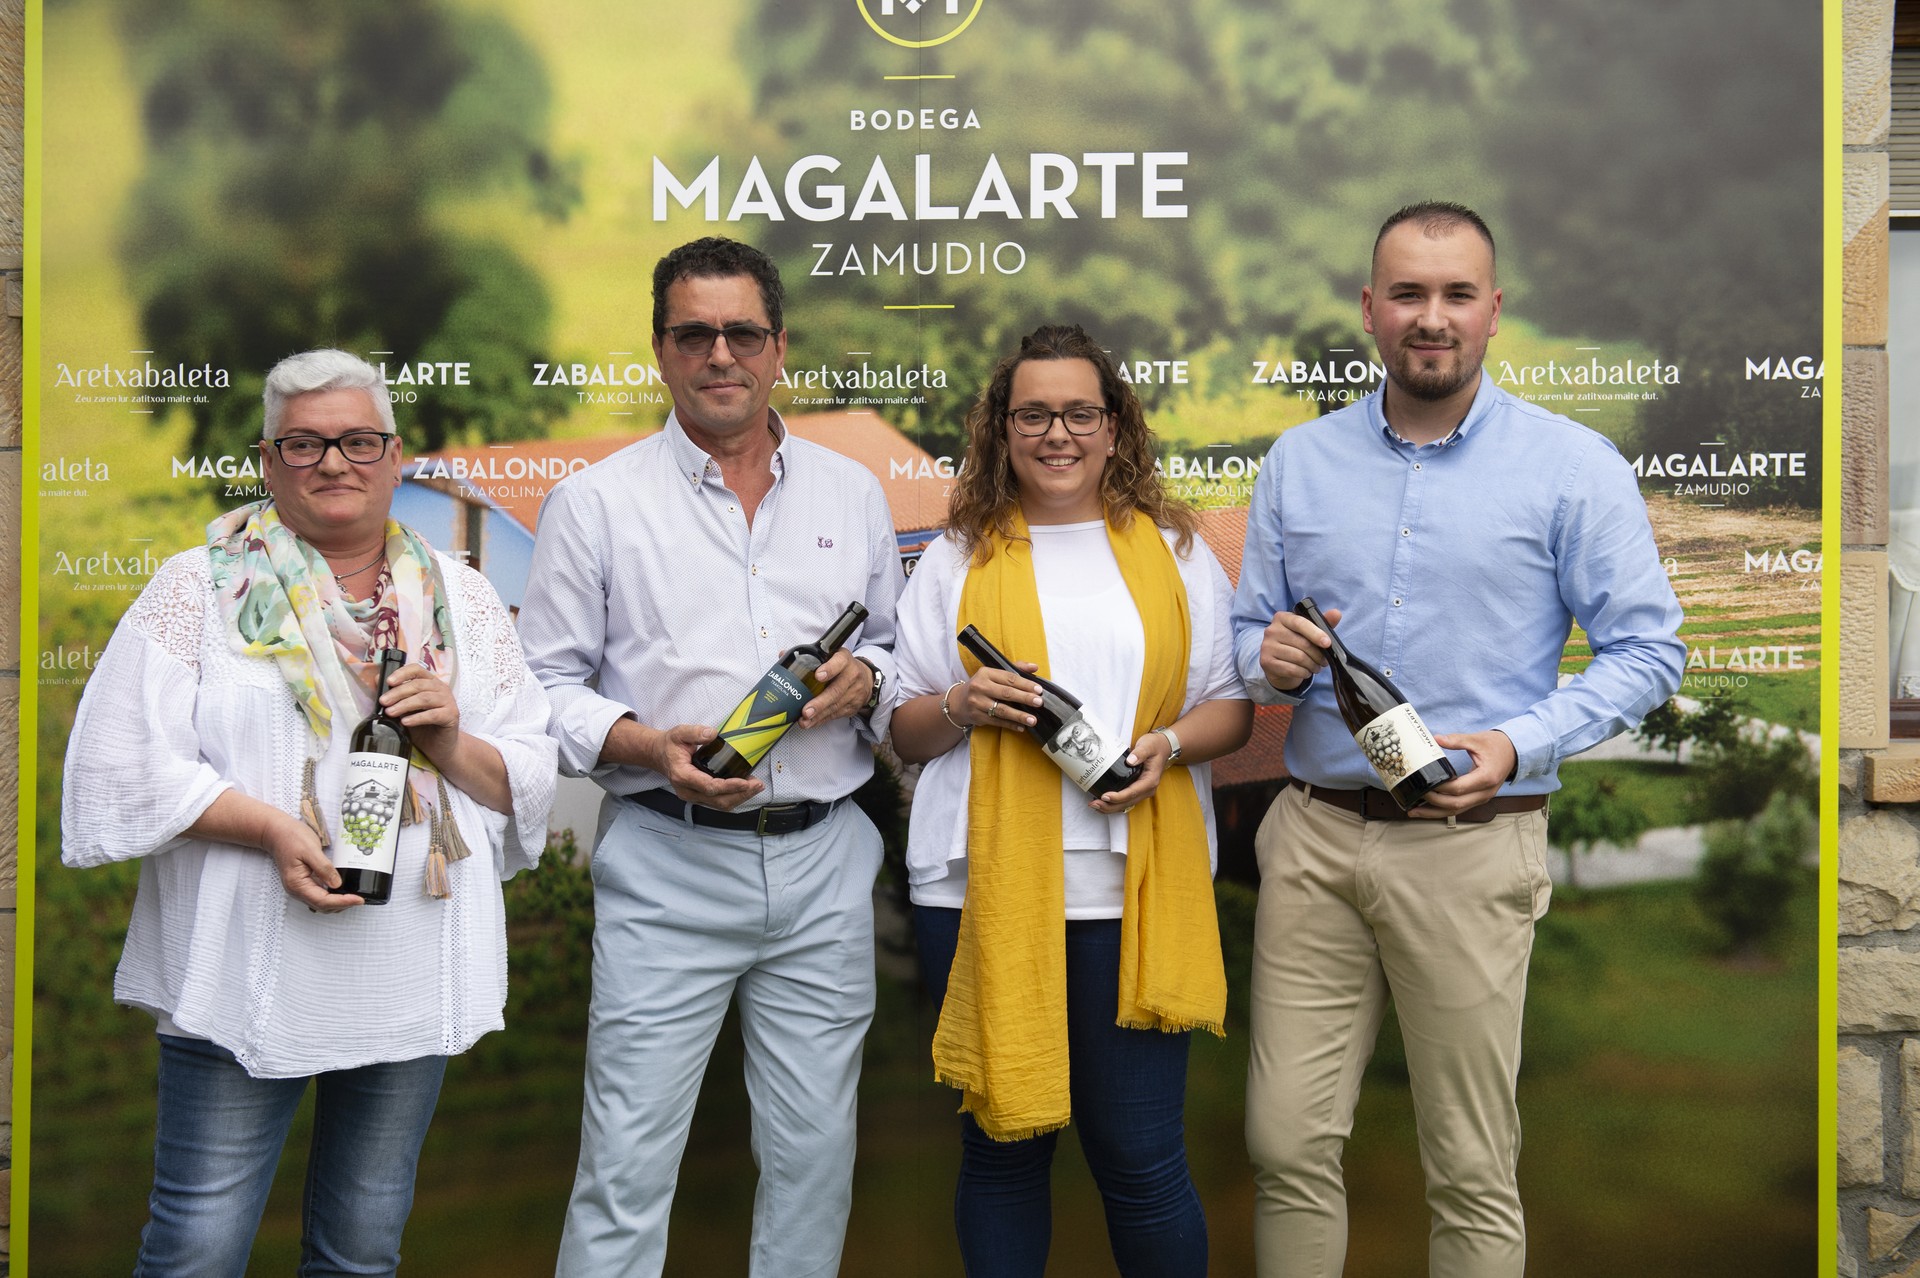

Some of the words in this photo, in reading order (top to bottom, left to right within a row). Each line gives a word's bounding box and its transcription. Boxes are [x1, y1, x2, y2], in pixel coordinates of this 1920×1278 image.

[850, 109, 981, 131] BODEGA
[653, 152, 1188, 221] MAGALARTE
[810, 242, 1026, 276] ZAMUDIO
[54, 361, 230, 388] Aretxabaleta
[380, 362, 471, 385] LARTE
[772, 362, 948, 389] Aretxabaleta
[1251, 361, 1387, 383] ZABALON
[1497, 357, 1681, 385] Aretxabaleta
[75, 394, 91, 403] Zeu
[93, 395, 116, 403] zaren
[118, 394, 128, 403] lur
[131, 394, 165, 403] zatitxoa
[167, 394, 191, 403] maite
[193, 394, 209, 404] dut.
[576, 392, 665, 404] TXAKOLINA
[792, 396, 809, 404] Zeu
[811, 396, 834, 404] zaren
[836, 395, 846, 404] lur
[848, 396, 883, 404] zatitxoa
[884, 395, 909, 404] maite
[910, 395, 927, 404] dut.
[1519, 392, 1536, 401] Zeu
[1538, 393, 1562, 401] zaren
[1563, 392, 1574, 401] lur
[1577, 392, 1613, 401] zatitxoa
[1614, 391, 1640, 401] maite
[1641, 391, 1659, 401] dut.
[39, 456, 110, 482] aleta
[48, 488, 72, 497] maite
[73, 488, 90, 497] dut.
[458, 485, 546, 498] TXAKOLINA
[1674, 483, 1749, 496] ZAMUDIO
[73, 582, 90, 591] Zeu
[92, 583, 116, 591] zaren
[117, 582, 127, 591] lur
[38, 645, 104, 670] alet
[1686, 645, 1805, 669] ALARTE
[46, 676, 70, 685] maite
[767, 670, 802, 701] ZABALONDO
[1682, 675, 1748, 688] AMUDIO
[350, 759, 399, 772] MAGALARTE
